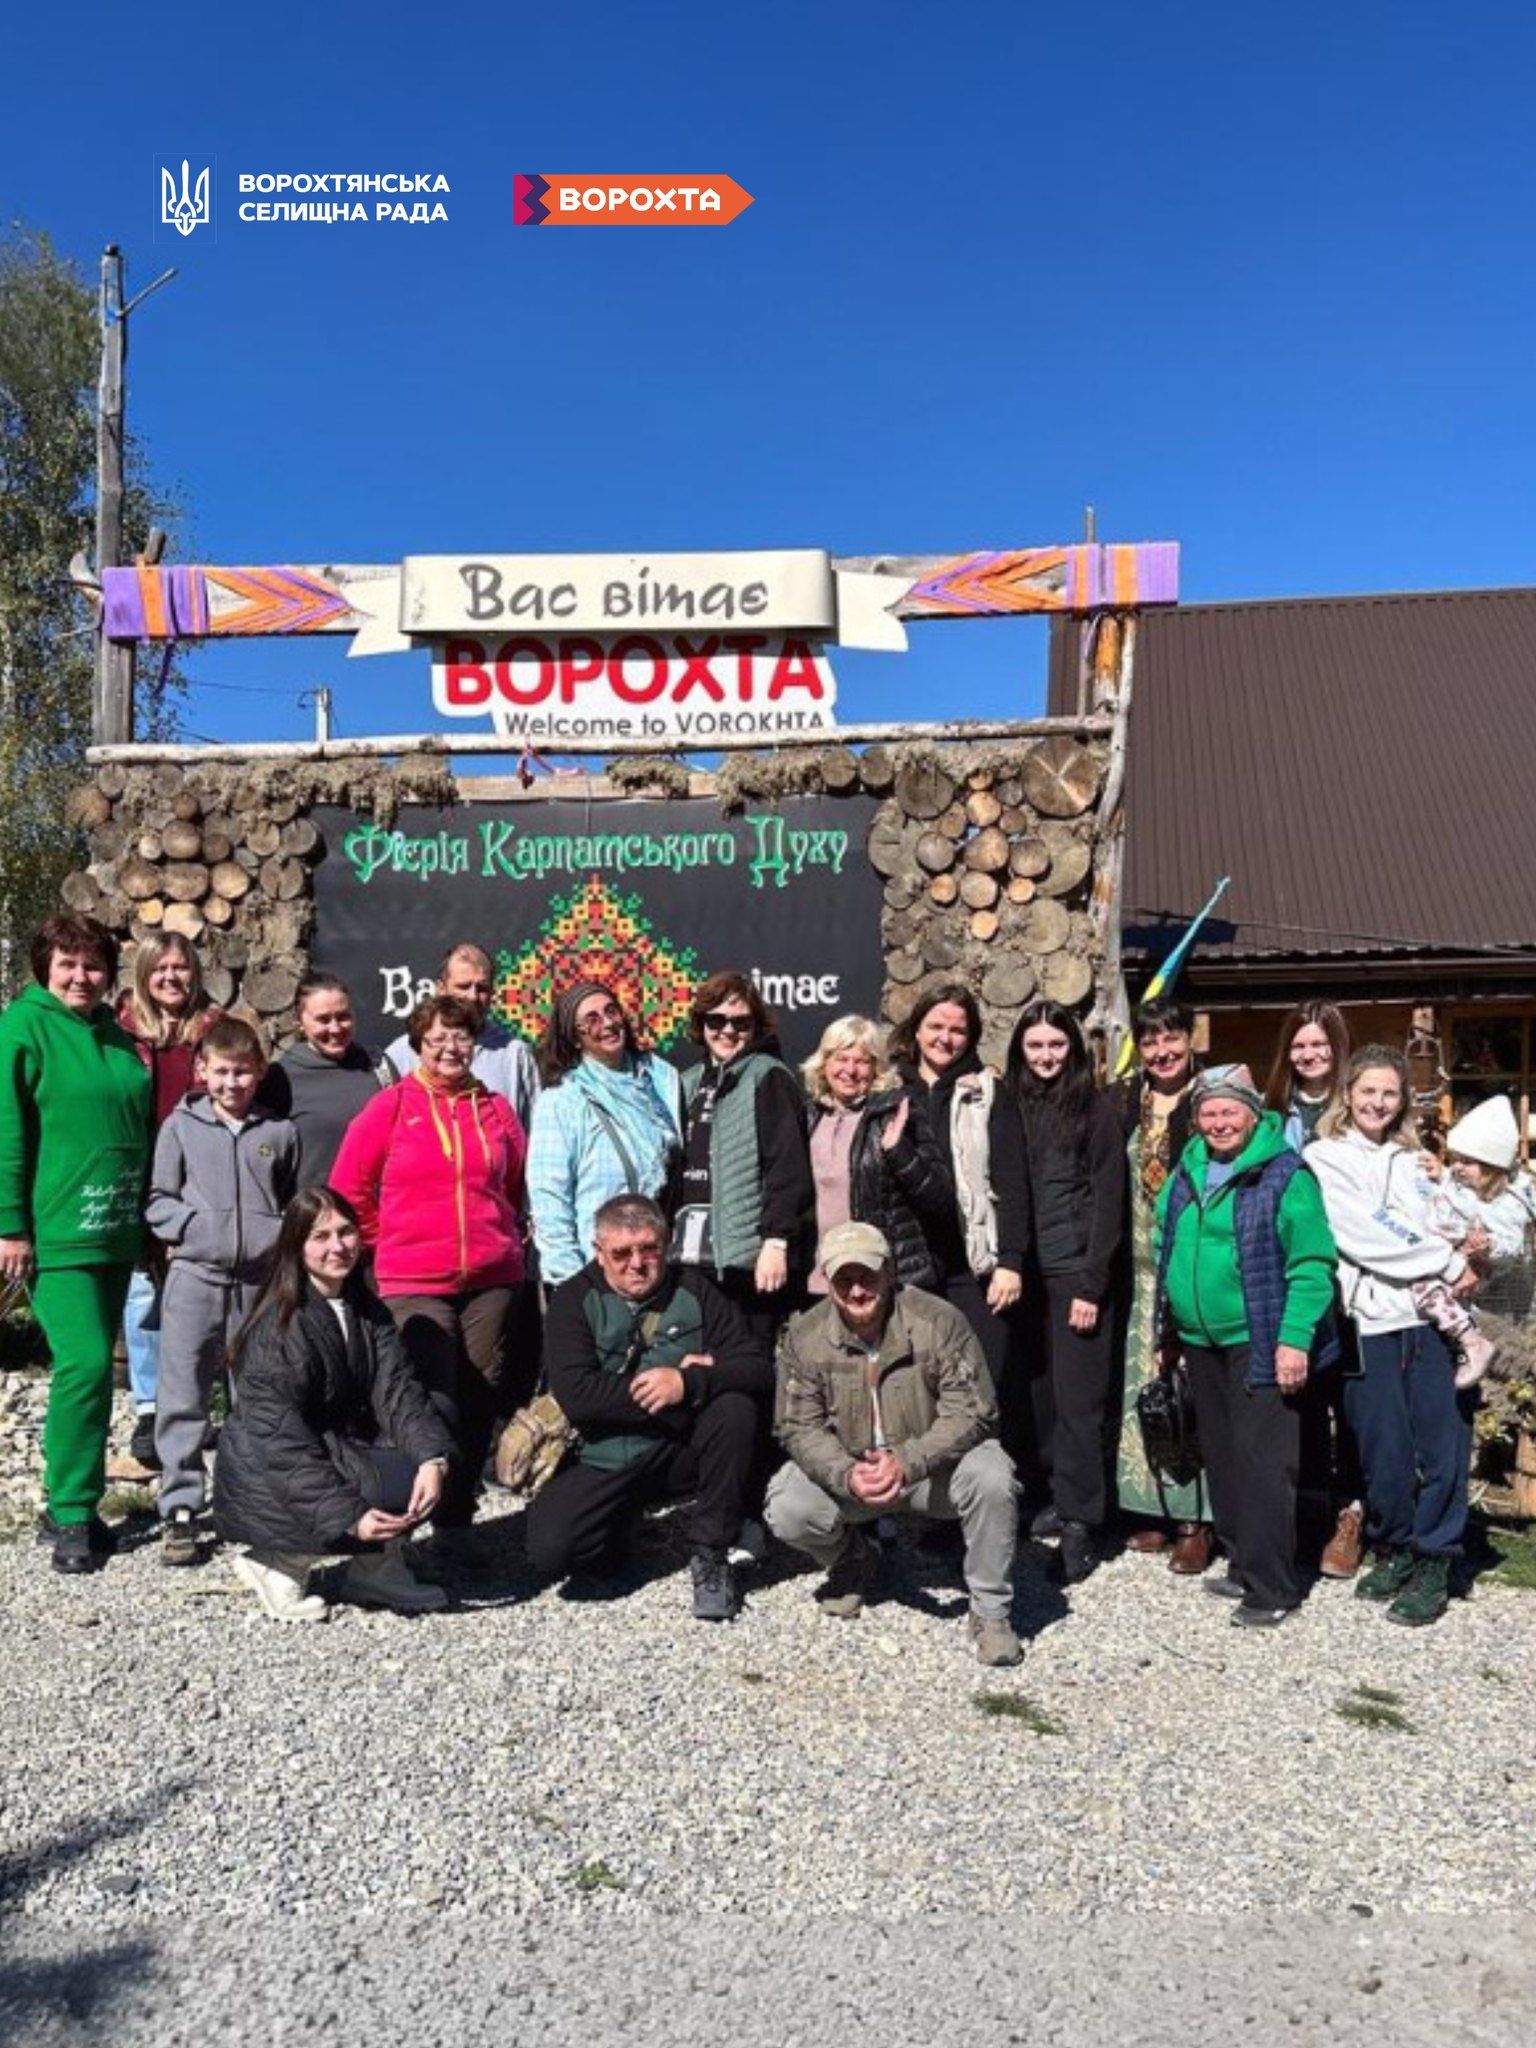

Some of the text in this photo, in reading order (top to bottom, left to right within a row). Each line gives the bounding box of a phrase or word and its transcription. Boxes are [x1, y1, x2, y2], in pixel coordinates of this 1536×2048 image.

[458, 563, 769, 621] Вас вітає
[444, 635, 826, 706] ВОРОХТА
[504, 710, 825, 736] Welcome to VOROKHTA
[477, 820, 736, 880] Карпатського
[743, 815, 848, 888] Духу
[378, 965, 437, 1018] Ва
